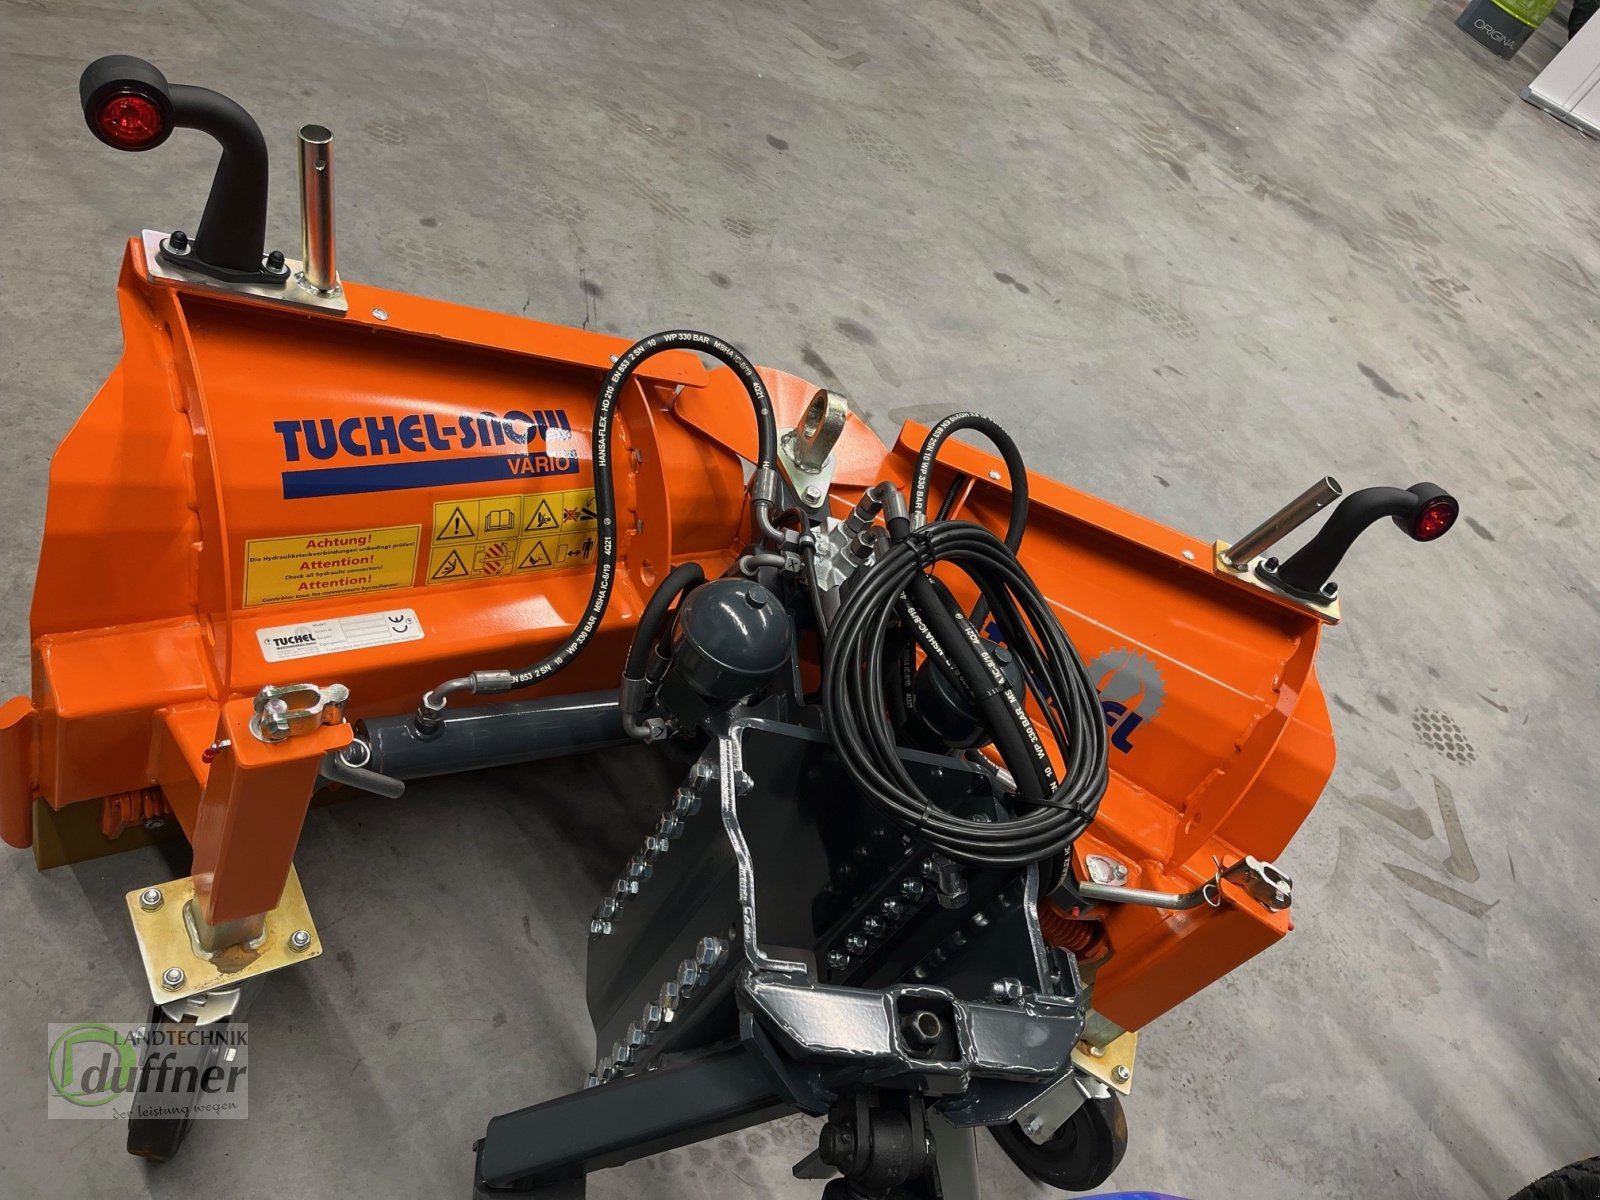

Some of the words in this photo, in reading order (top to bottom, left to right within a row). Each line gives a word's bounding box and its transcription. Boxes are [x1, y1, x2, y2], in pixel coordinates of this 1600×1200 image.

[1473, 18, 1515, 50] ORIGINA
[647, 339, 657, 347] 10
[664, 333, 677, 342] WP
[678, 333, 691, 341] 330
[693, 334, 710, 344] BAR
[713, 341, 734, 358] MSHA
[619, 360, 630, 373] 853
[611, 371, 622, 383] EN
[605, 386, 614, 399] 210
[752, 382, 765, 399] 4Q21
[601, 399, 610, 411] HD
[598, 416, 607, 467] HANSA-FLEX
[923, 452, 931, 460] 10
[507, 456, 571, 475] VARIO
[920, 462, 930, 476] WP
[917, 475, 927, 490] 330
[915, 491, 924, 511] BAR
[306, 534, 372, 549] Achtung!
[604, 536, 612, 556] 4Q21
[263, 548, 358, 562] Hydrauliksteckverbindungen
[299, 555, 374, 570] Attention!
[315, 568, 346, 577] hydraulic
[347, 565, 384, 573] connectors!
[600, 564, 611, 590] IC-8/19
[298, 575, 372, 591] Attention!
[593, 591, 607, 613] MSHA
[584, 615, 597, 634] BAR
[907, 607, 928, 634] IC-8/19
[273, 633, 316, 647] TUCHEL
[576, 631, 588, 645] 330
[965, 627, 980, 645] 4Q21
[566, 642, 578, 655] WP
[554, 656, 563, 666] 10
[981, 651, 1002, 679] IC-8/19
[520, 672, 533, 682] 853
[998, 678, 1017, 704] MSA
[1015, 706, 1030, 728] BAR
[1026, 727, 1038, 743] 330
[1034, 744, 1045, 760] WP
[1044, 766, 1053, 778] 10
